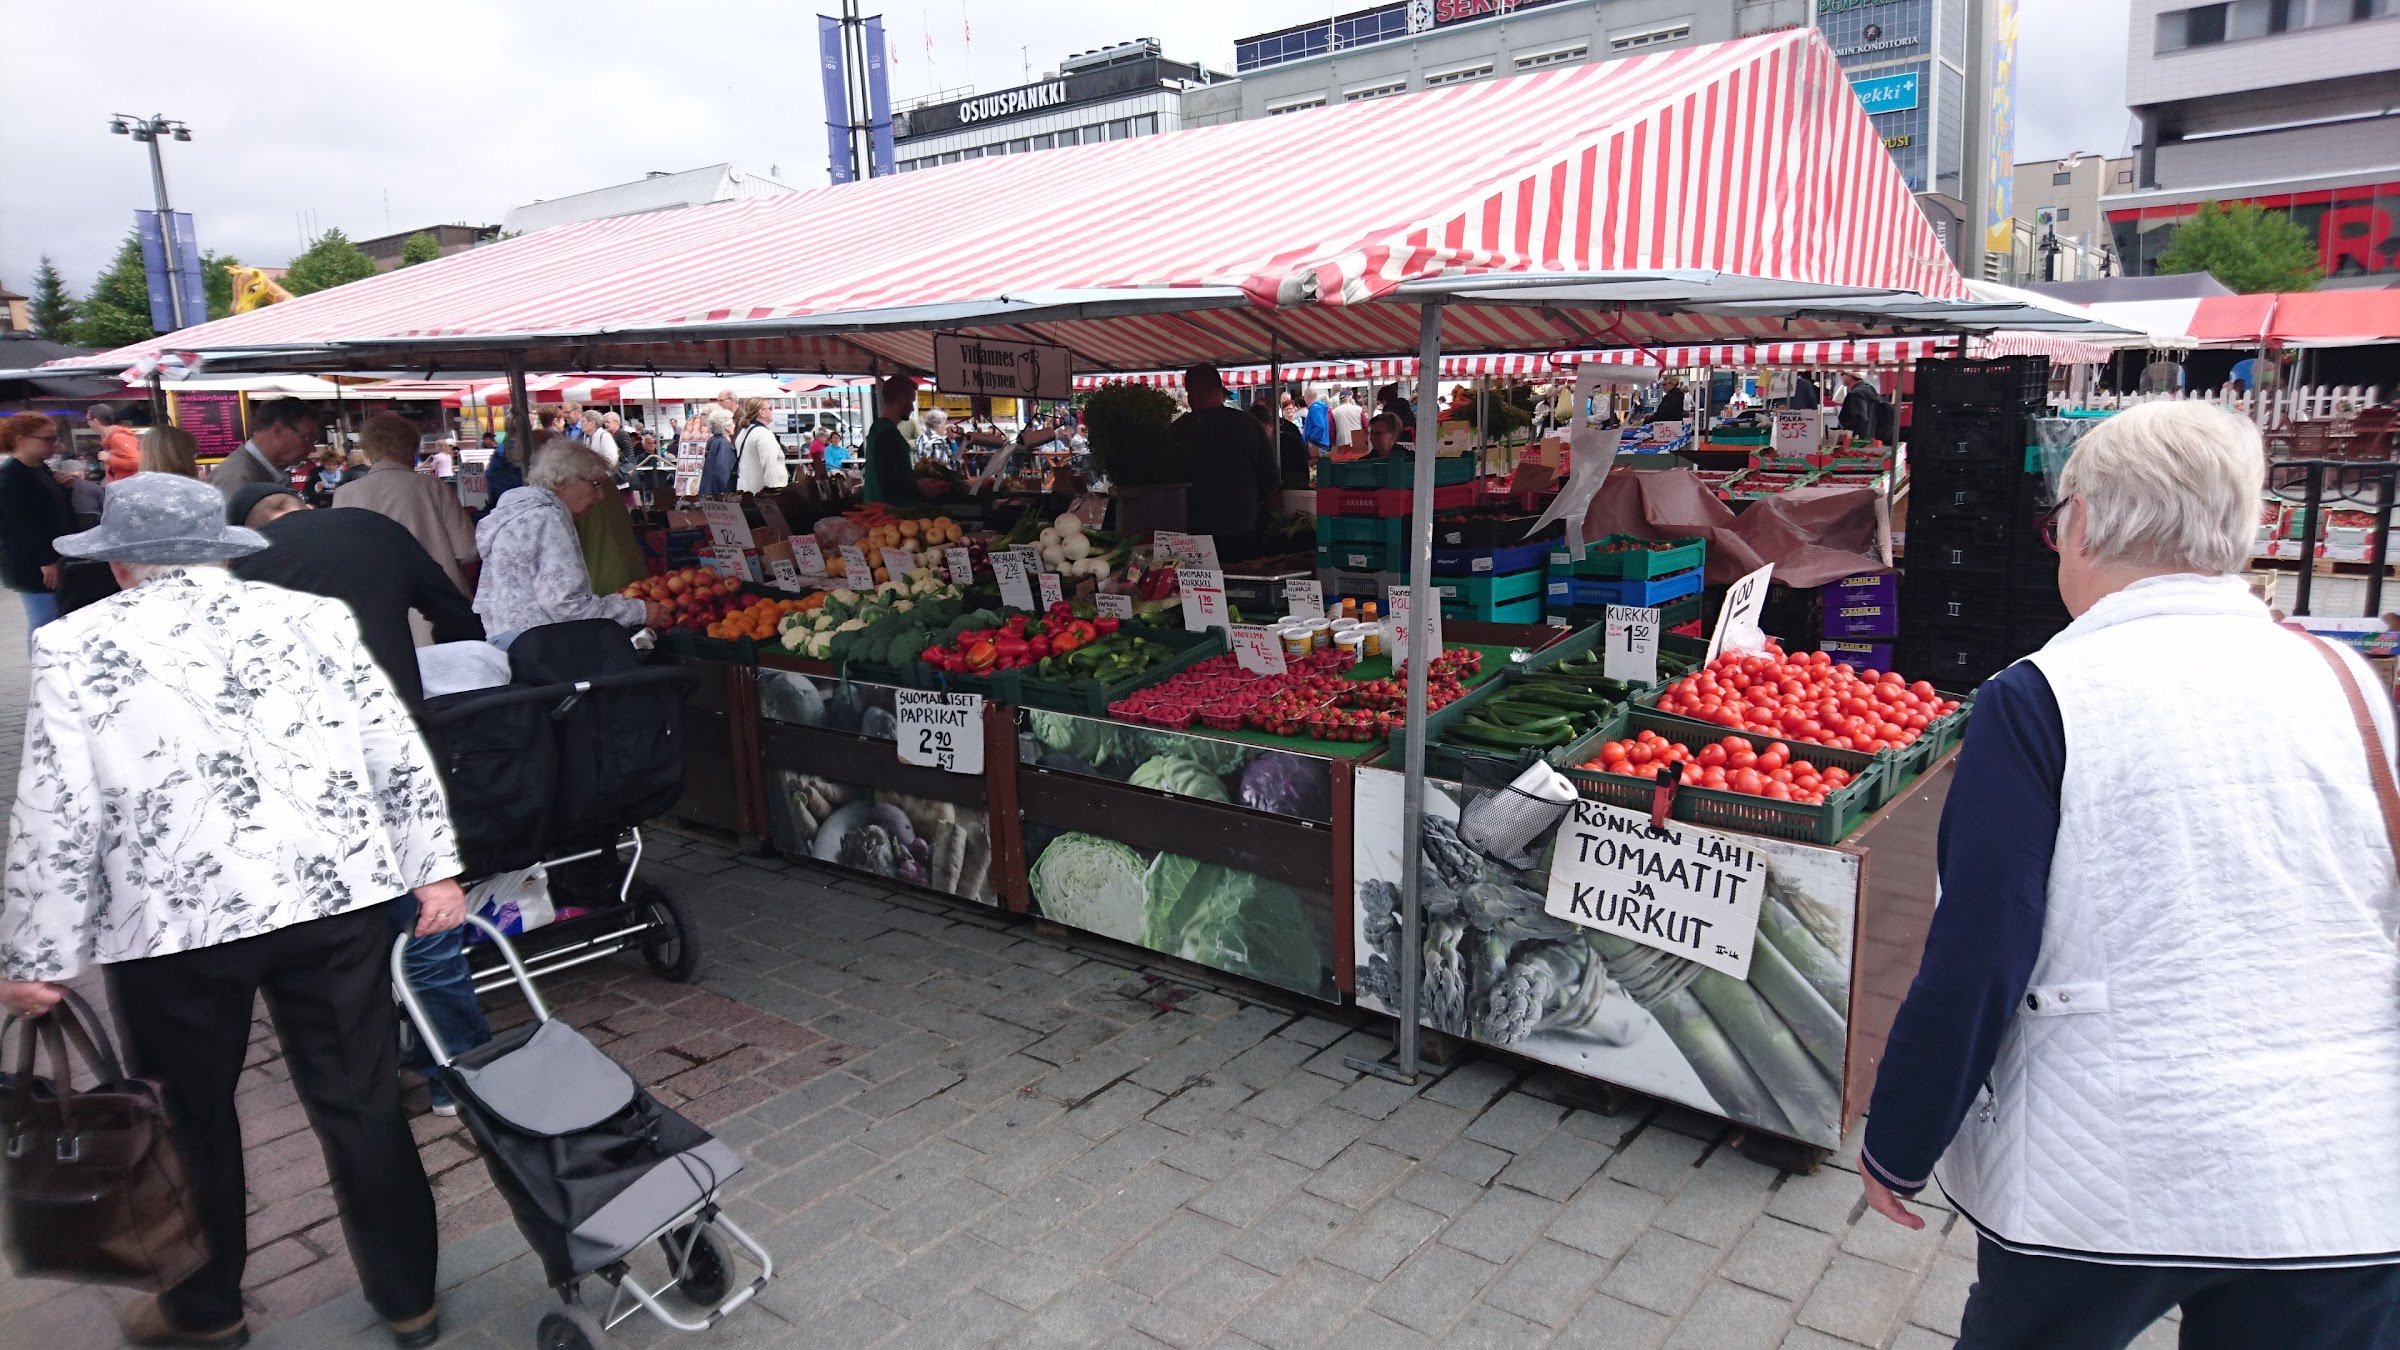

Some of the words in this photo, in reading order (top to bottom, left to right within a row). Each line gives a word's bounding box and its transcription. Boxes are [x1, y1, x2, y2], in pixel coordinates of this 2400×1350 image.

[1858, 36, 1919, 53] KONDITORIA
[960, 81, 1067, 123] OSUUSPANKKI
[960, 343, 1015, 368] Vihannes
[972, 370, 1016, 390] Myllynen
[1179, 570, 1212, 579] AVOMAAN
[1389, 587, 1410, 597] Suone
[1390, 596, 1410, 610] POL
[1607, 606, 1660, 625] KURKKU
[1233, 631, 1265, 640] VADELMA
[899, 691, 976, 707] SUOMALISET
[900, 707, 969, 727] PAPRIKAT
[1573, 800, 1682, 846] RÖNKÖN
[1575, 832, 1748, 905] TOMAATIT
[1627, 880, 1656, 901] JA
[1569, 882, 1714, 949] KURKUT
